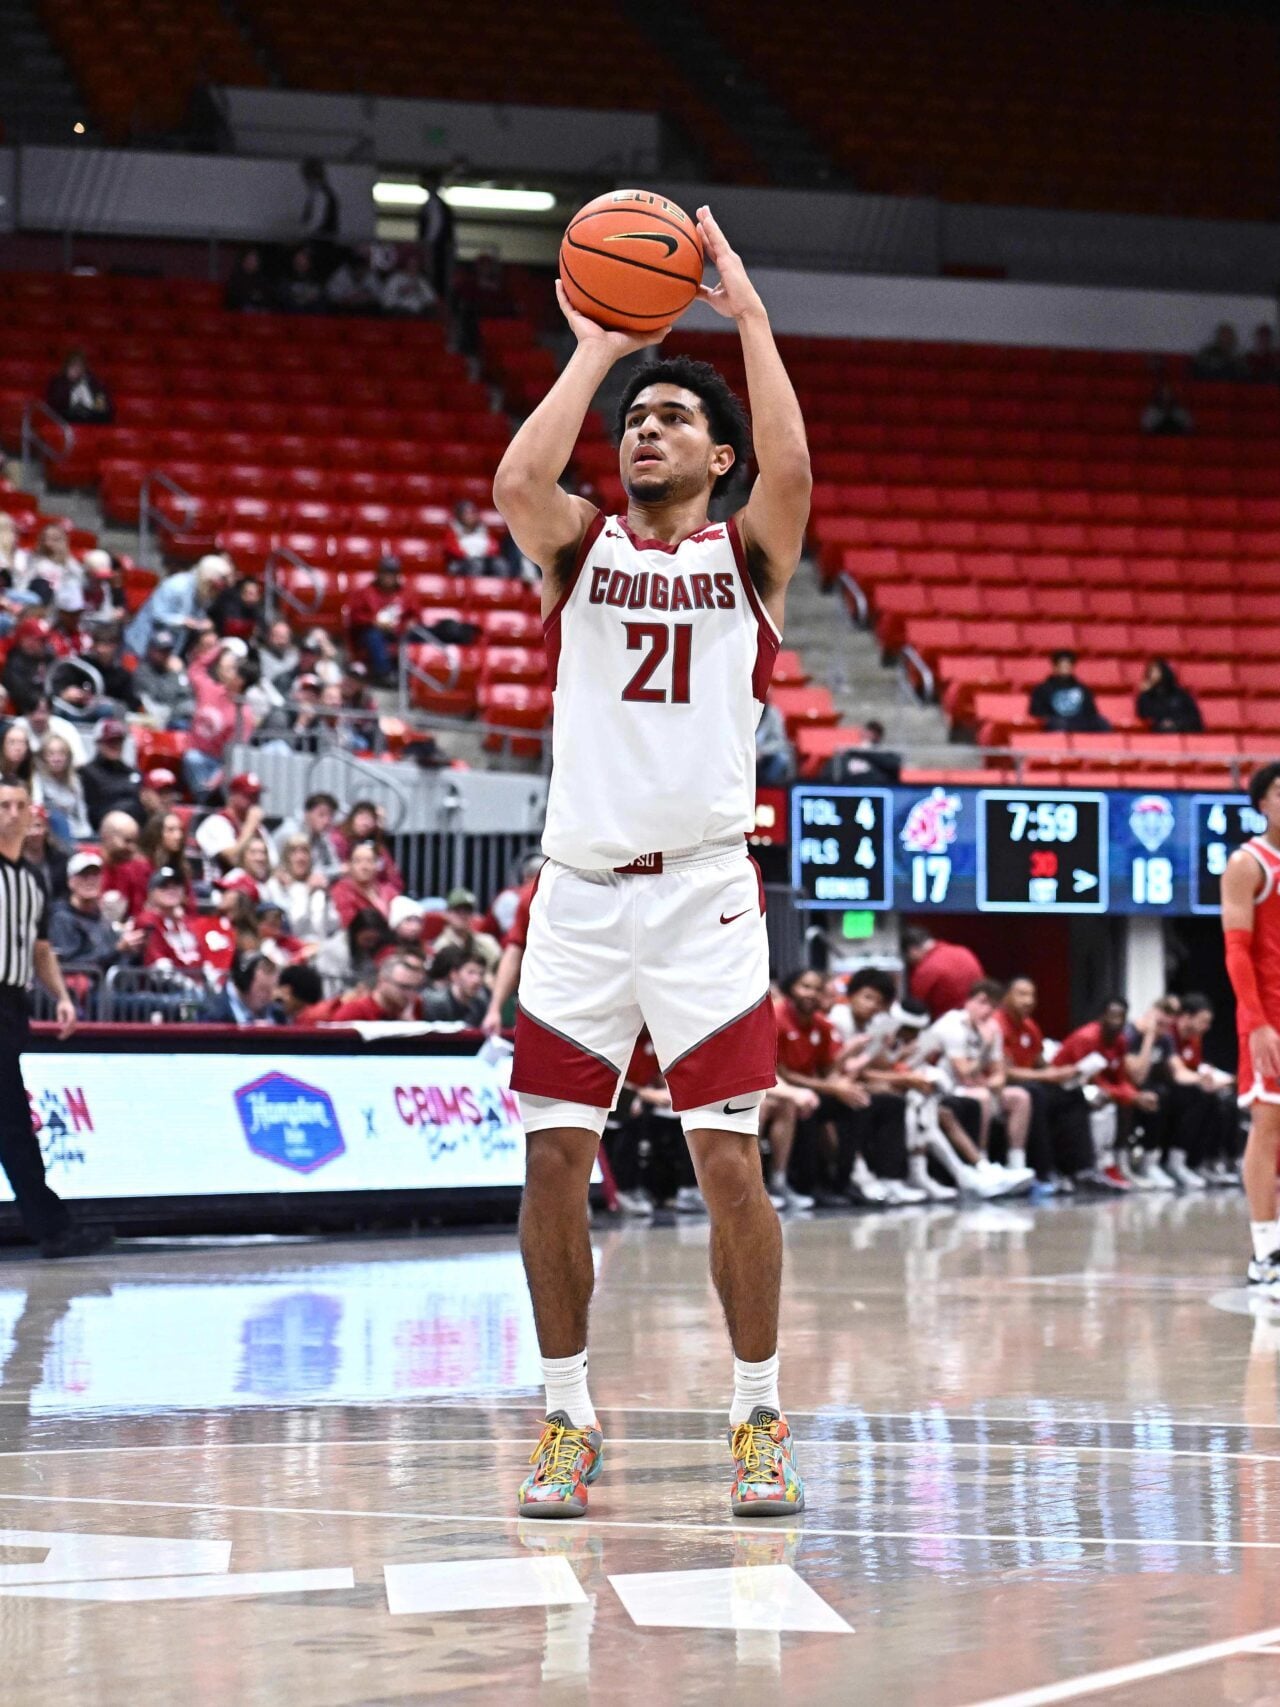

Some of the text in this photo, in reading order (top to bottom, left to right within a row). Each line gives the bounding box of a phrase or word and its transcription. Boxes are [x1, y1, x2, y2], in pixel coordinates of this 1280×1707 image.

[588, 566, 736, 612] COUGARS
[621, 621, 693, 704] 21
[855, 797, 876, 831] 4
[1006, 802, 1078, 842] 7:59
[854, 836, 876, 870] 4
[912, 855, 952, 903] 17
[1131, 857, 1173, 904] 18
